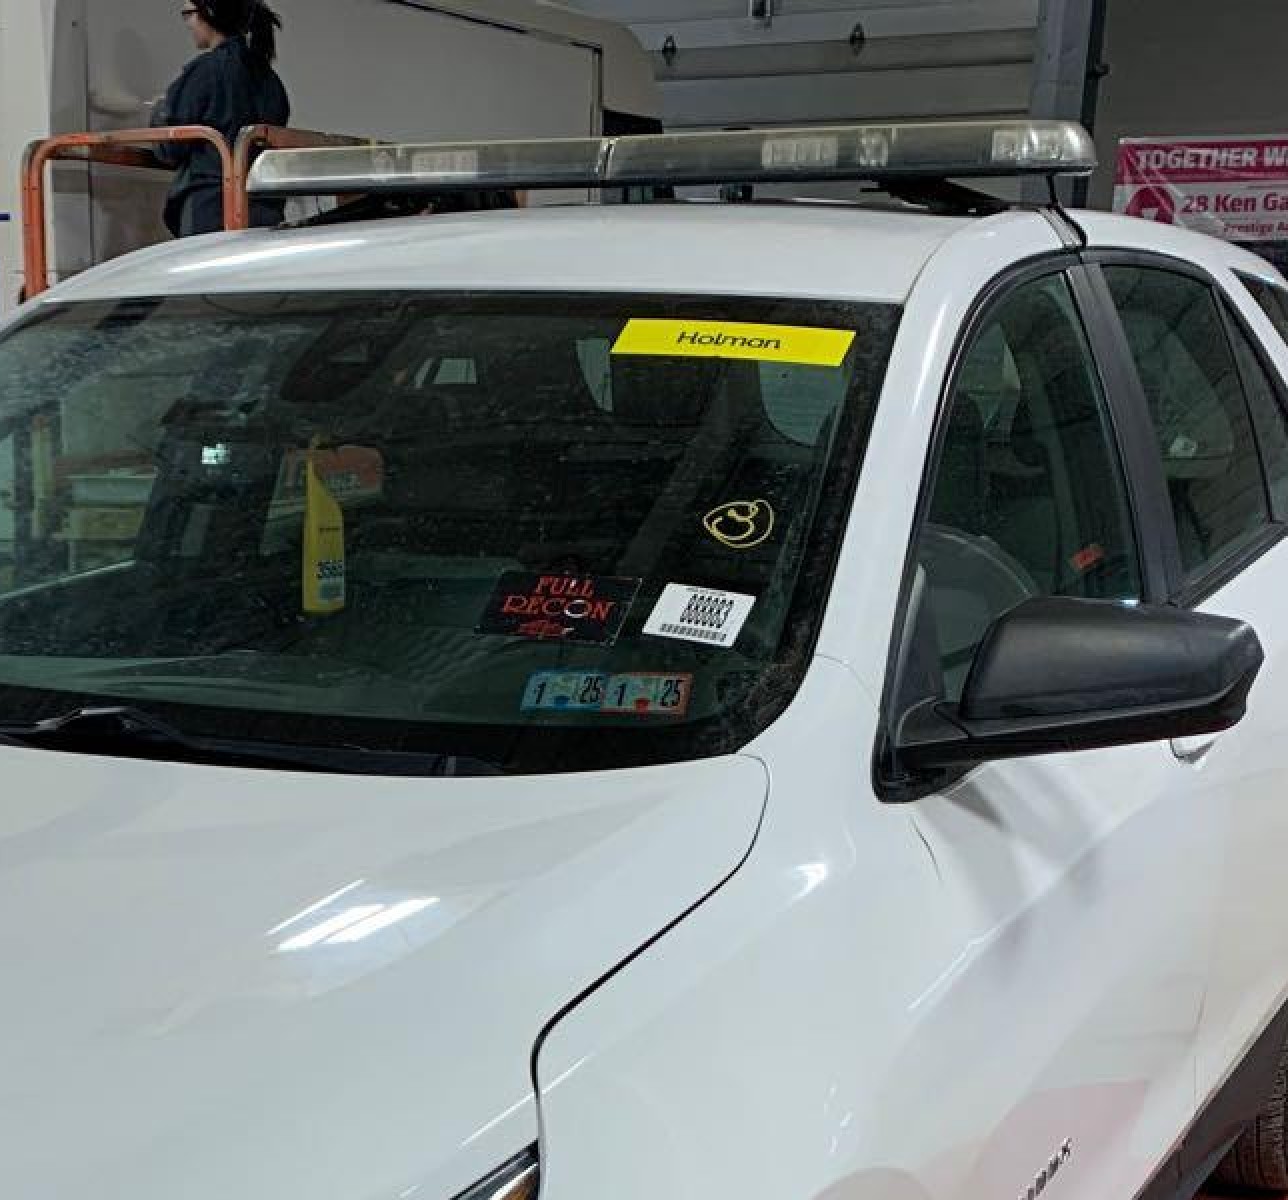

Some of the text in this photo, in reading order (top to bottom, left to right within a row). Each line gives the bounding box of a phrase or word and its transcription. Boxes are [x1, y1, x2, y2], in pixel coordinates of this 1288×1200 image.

[1136, 147, 1258, 169] TOGETHER
[1182, 195, 1209, 213] 28
[1215, 193, 1257, 212] Ken
[677, 331, 781, 349] Holman
[535, 575, 594, 597] FULL
[502, 595, 616, 621] RECON
[660, 679, 685, 707] 25
